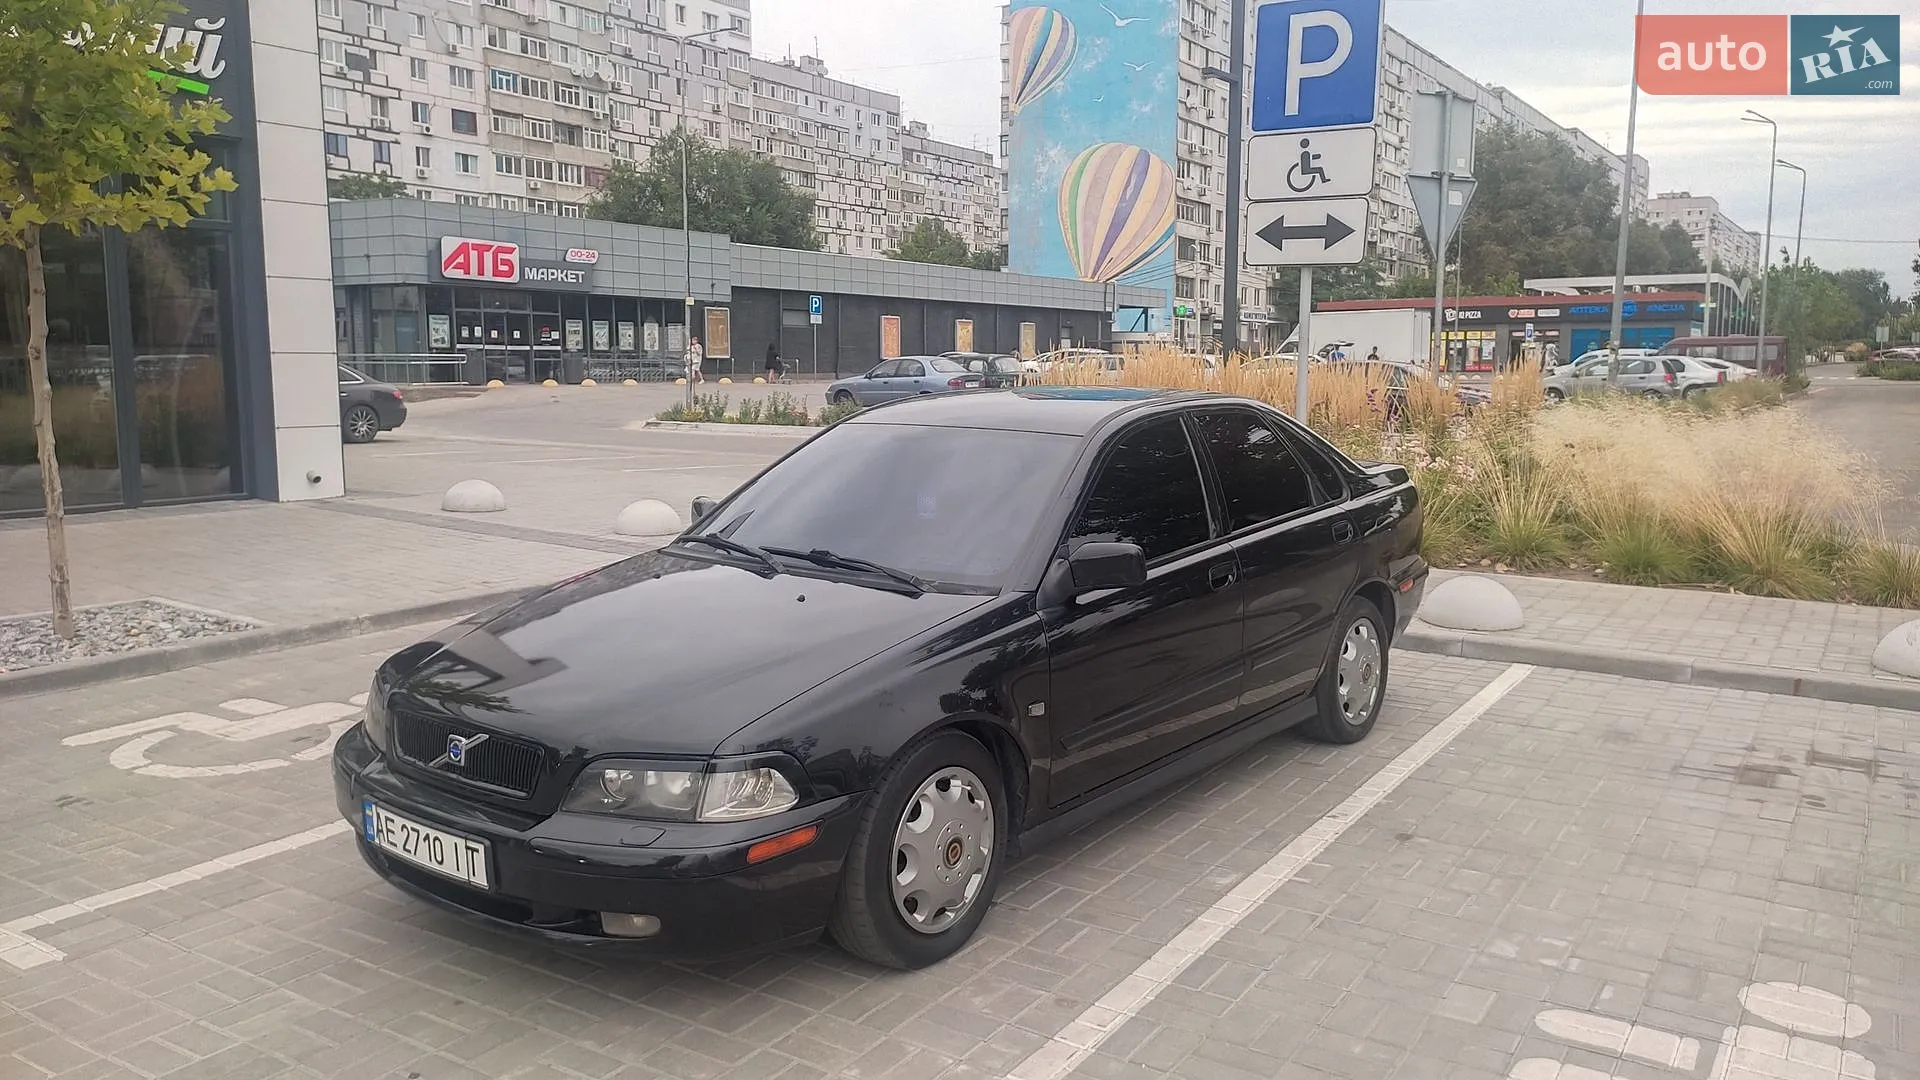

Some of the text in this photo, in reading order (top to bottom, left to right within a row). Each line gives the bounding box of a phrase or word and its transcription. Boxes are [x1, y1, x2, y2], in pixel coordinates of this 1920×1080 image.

[1285, 10, 1353, 117] P
[443, 242, 585, 283] АТБ МАРКЕТ
[812, 297, 820, 312] P
[376, 811, 397, 849] AE
[401, 823, 444, 866] 2710
